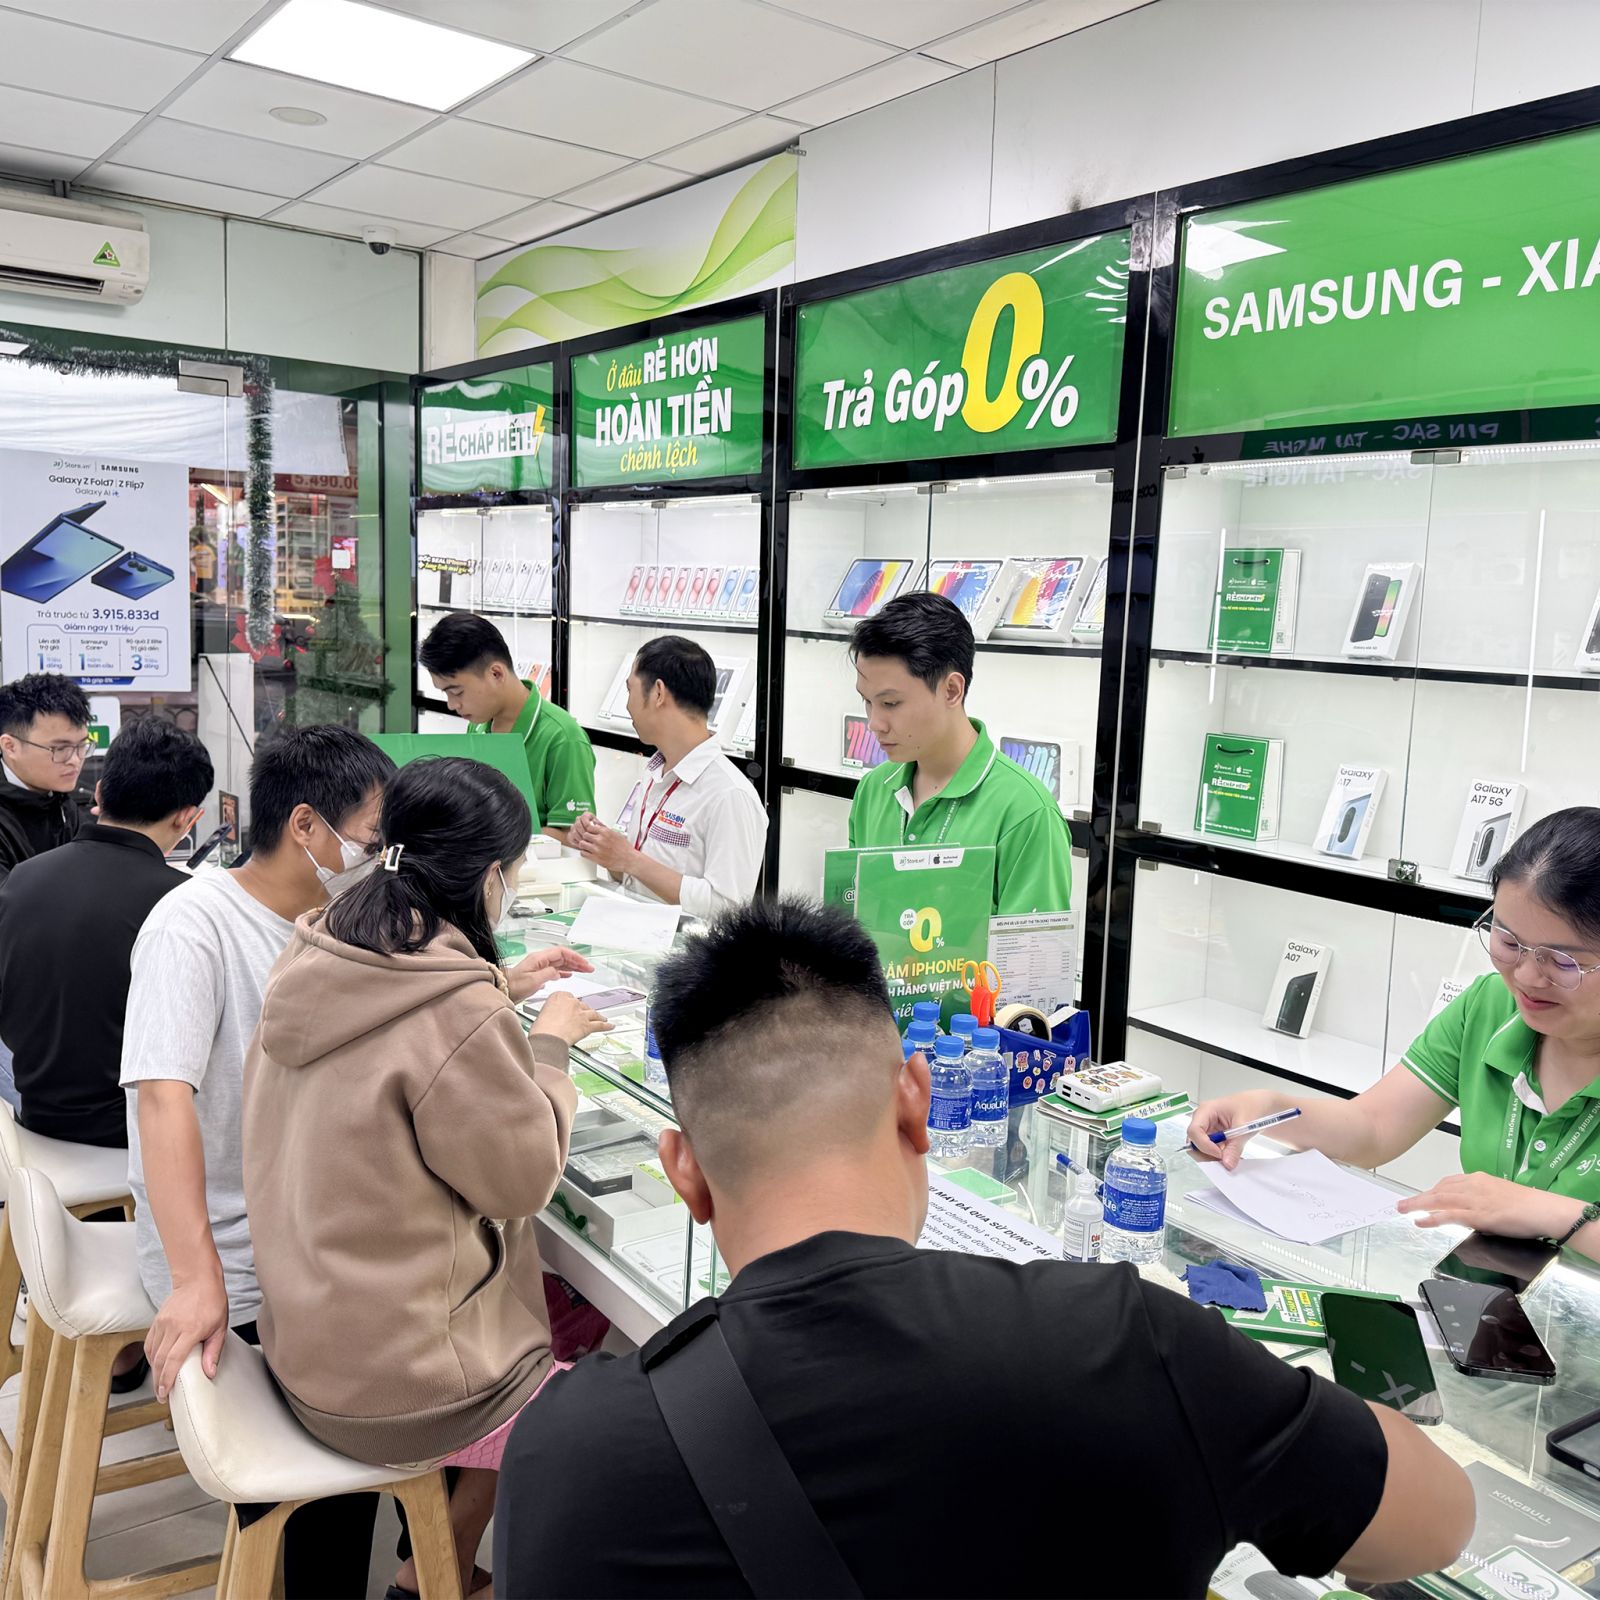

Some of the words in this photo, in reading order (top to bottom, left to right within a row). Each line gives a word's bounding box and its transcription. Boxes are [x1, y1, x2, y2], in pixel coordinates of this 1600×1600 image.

[1203, 258, 1462, 340] SAMSUNG
[606, 359, 618, 392] Ở
[617, 363, 643, 388] đâu
[643, 338, 666, 384] RẺ
[670, 337, 718, 378] HƠN
[822, 368, 875, 430] Trả
[884, 360, 964, 432] Góp
[595, 393, 661, 447] HOÀN
[667, 375, 732, 438] TIỀN
[426, 411, 456, 465] RẺ
[459, 423, 494, 457] CHẤP
[620, 443, 662, 473] chênh
[665, 439, 698, 473] lệch
[101, 464, 140, 474] SAMSUNG
[48, 474, 83, 487] Galaxy
[83, 477, 90, 486] Z
[90, 477, 114, 487] Fold7
[119, 480, 126, 489] Z
[126, 480, 144, 490] Flip7
[75, 487, 102, 497] Galaxy
[87, 624, 108, 633] ngay
[37, 653, 44, 670] 1
[79, 653, 85, 671] 1
[131, 654, 143, 671] 3
[1340, 768, 1374, 780] Galaxy
[1474, 782, 1512, 797] Galaxy
[1470, 795, 1487, 804] A17
[1489, 796, 1504, 807] 5G
[1284, 952, 1301, 963] A07
[1288, 942, 1320, 957] Galaxy
[912, 958, 965, 977] IPHONE
[897, 983, 928, 997] HÃNG
[929, 978, 952, 993] VIỆT
[896, 1002, 914, 1018] siê
[970, 1210, 990, 1223] QUA
[1003, 1229, 1033, 1247] DỤNG
[990, 1236, 1016, 1253] CCCD
[1491, 1489, 1552, 1525] KINGBULL
